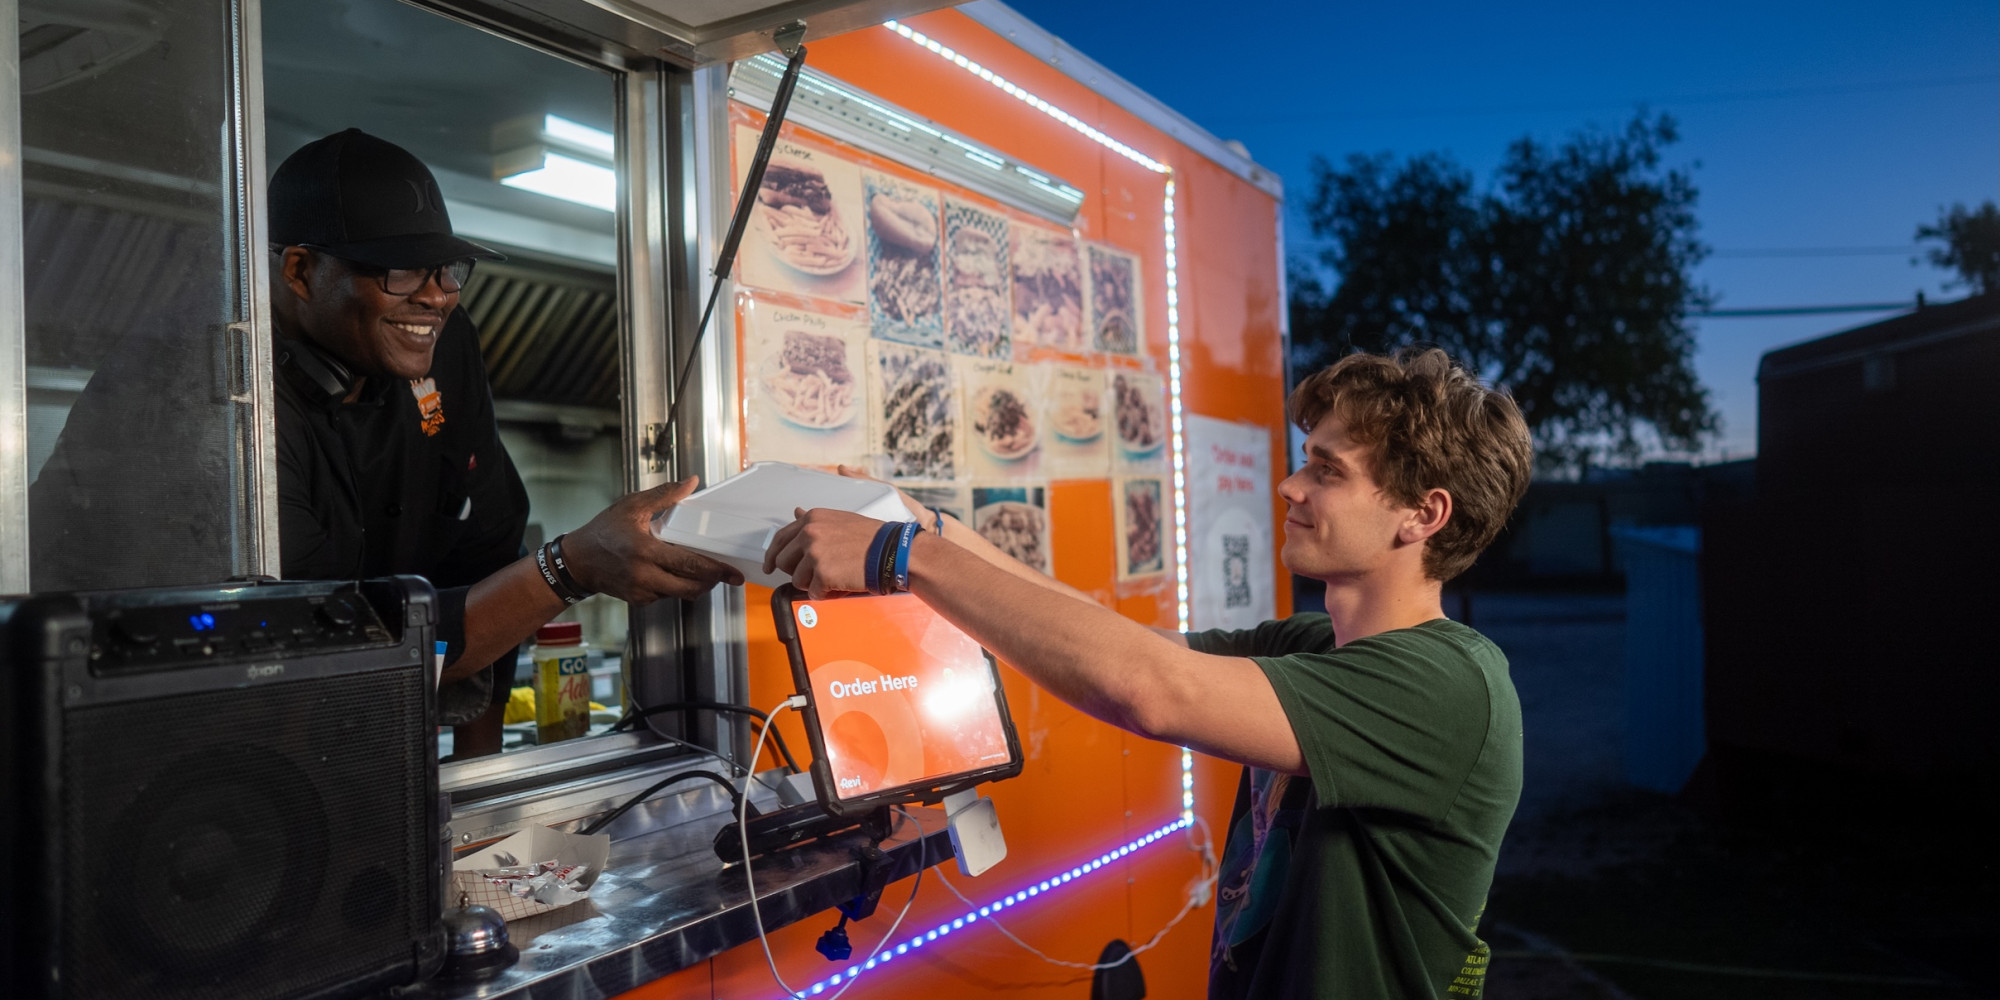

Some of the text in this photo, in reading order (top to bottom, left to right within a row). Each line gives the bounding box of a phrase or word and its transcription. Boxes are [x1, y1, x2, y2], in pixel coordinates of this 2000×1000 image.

[542, 567, 557, 585] LIVES
[561, 657, 586, 675] GO
[830, 675, 918, 698] Order Here
[840, 775, 861, 789] Revi
